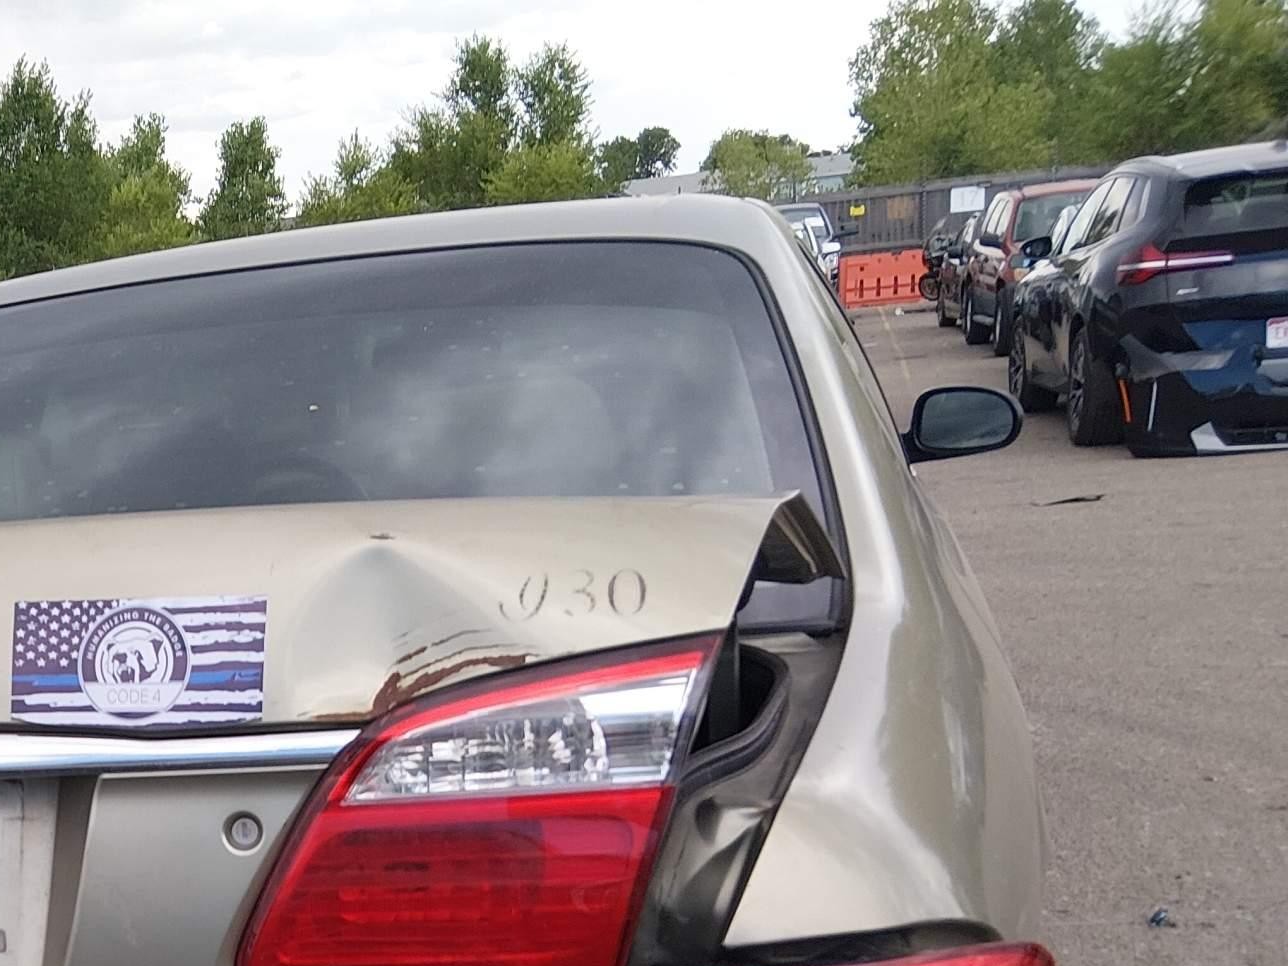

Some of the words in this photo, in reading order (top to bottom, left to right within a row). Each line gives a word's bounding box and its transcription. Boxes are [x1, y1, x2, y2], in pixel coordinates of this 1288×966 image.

[86, 610, 139, 660] HUMANIZING
[143, 611, 161, 625] THE
[162, 622, 183, 657] BADGE
[106, 687, 150, 704] CODE
[152, 688, 161, 704] 4
